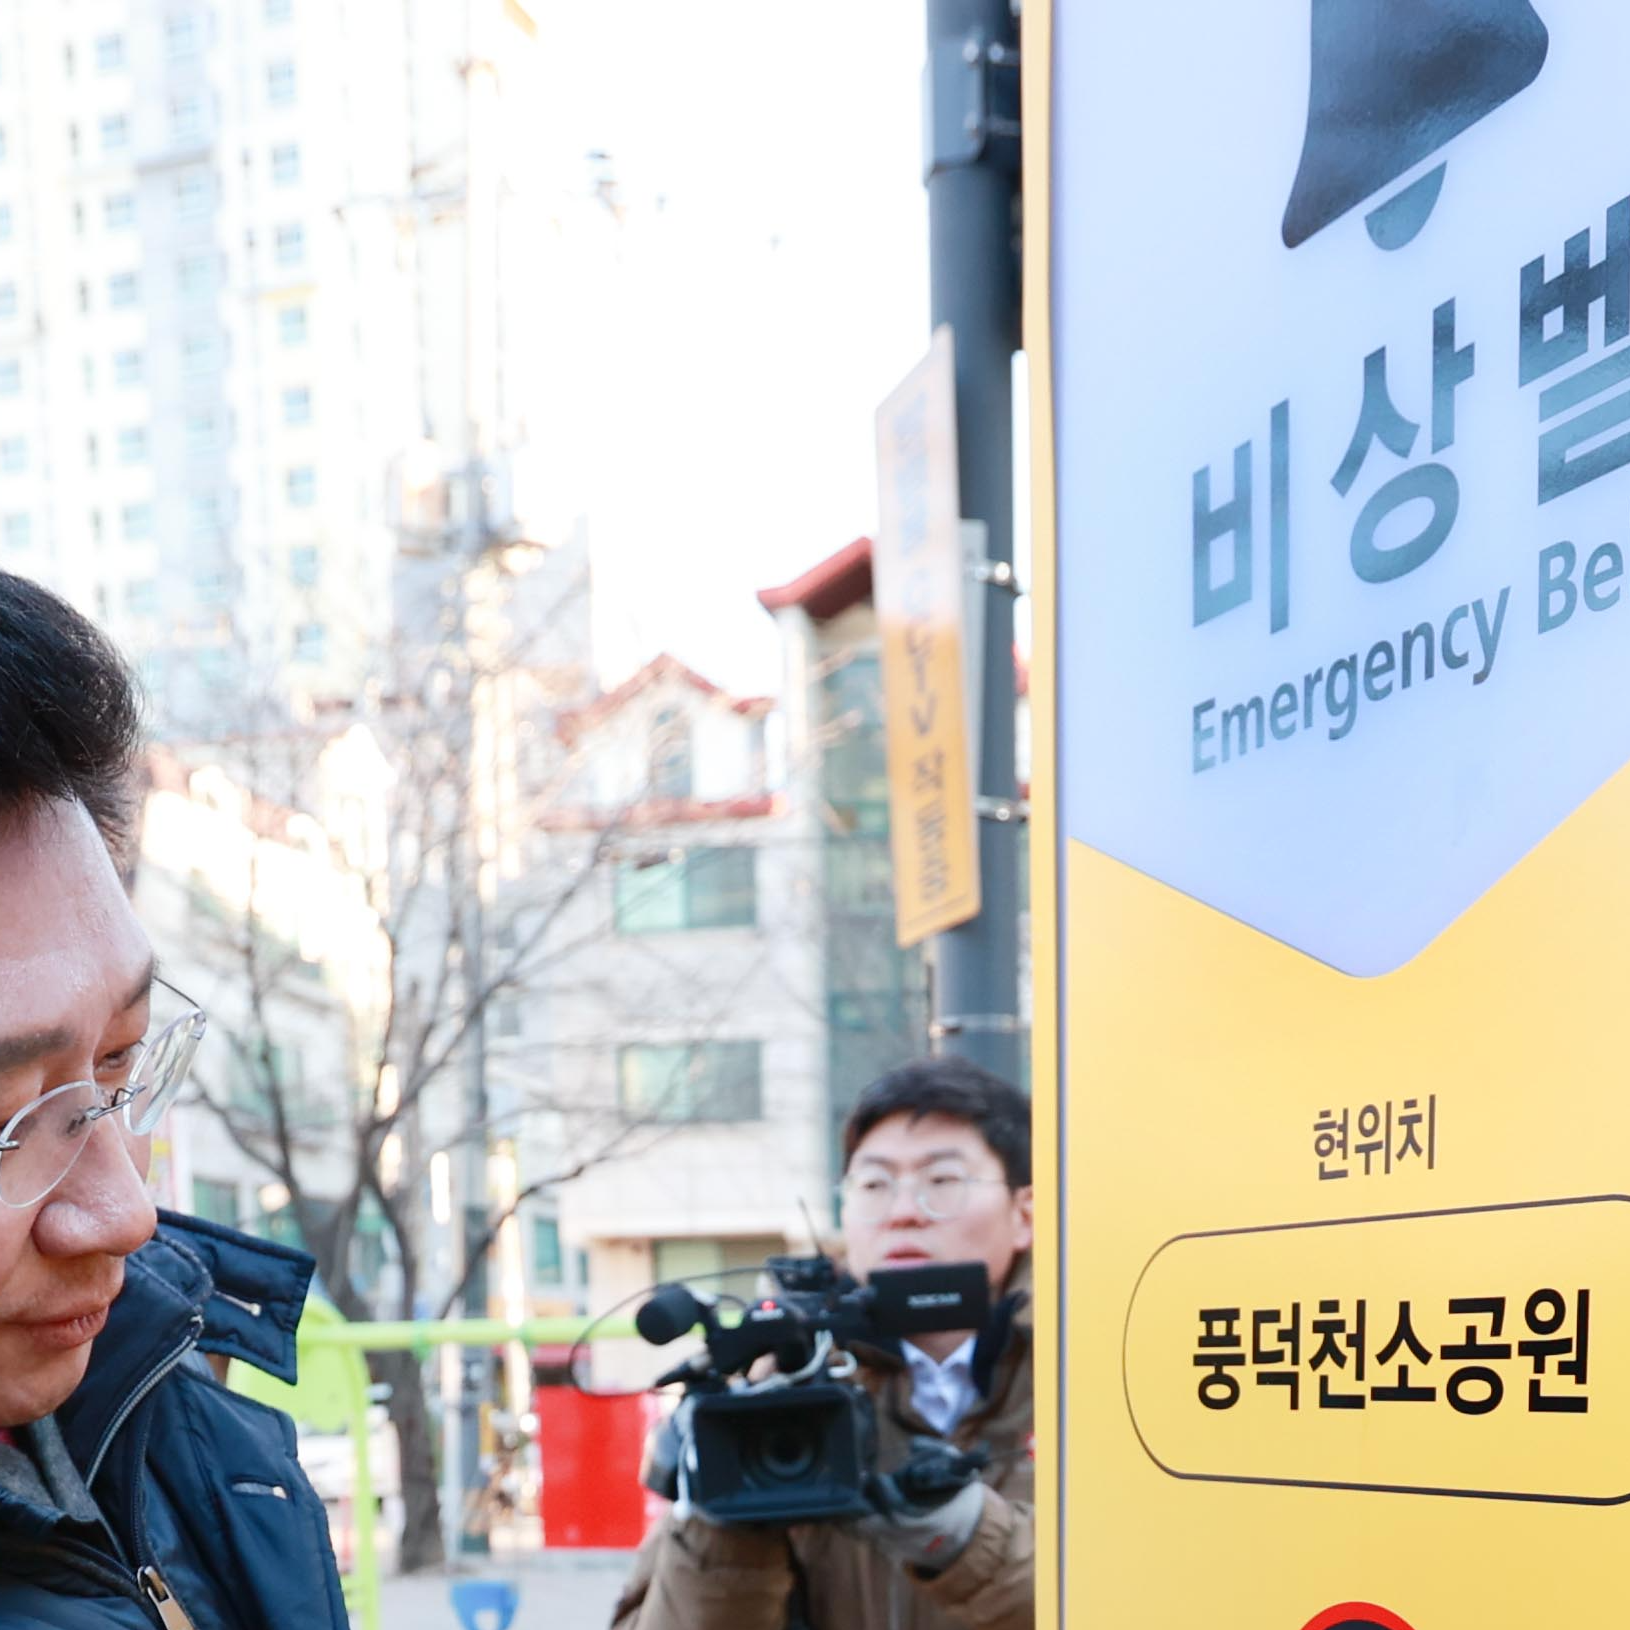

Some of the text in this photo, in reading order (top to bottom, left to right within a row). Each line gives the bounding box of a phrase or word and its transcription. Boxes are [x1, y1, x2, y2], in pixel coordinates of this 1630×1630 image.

[1192, 587, 1512, 774] Emergency
[1313, 1094, 1437, 1181] 현위치
[1192, 1287, 1591, 1415] 풍덕천소공원
